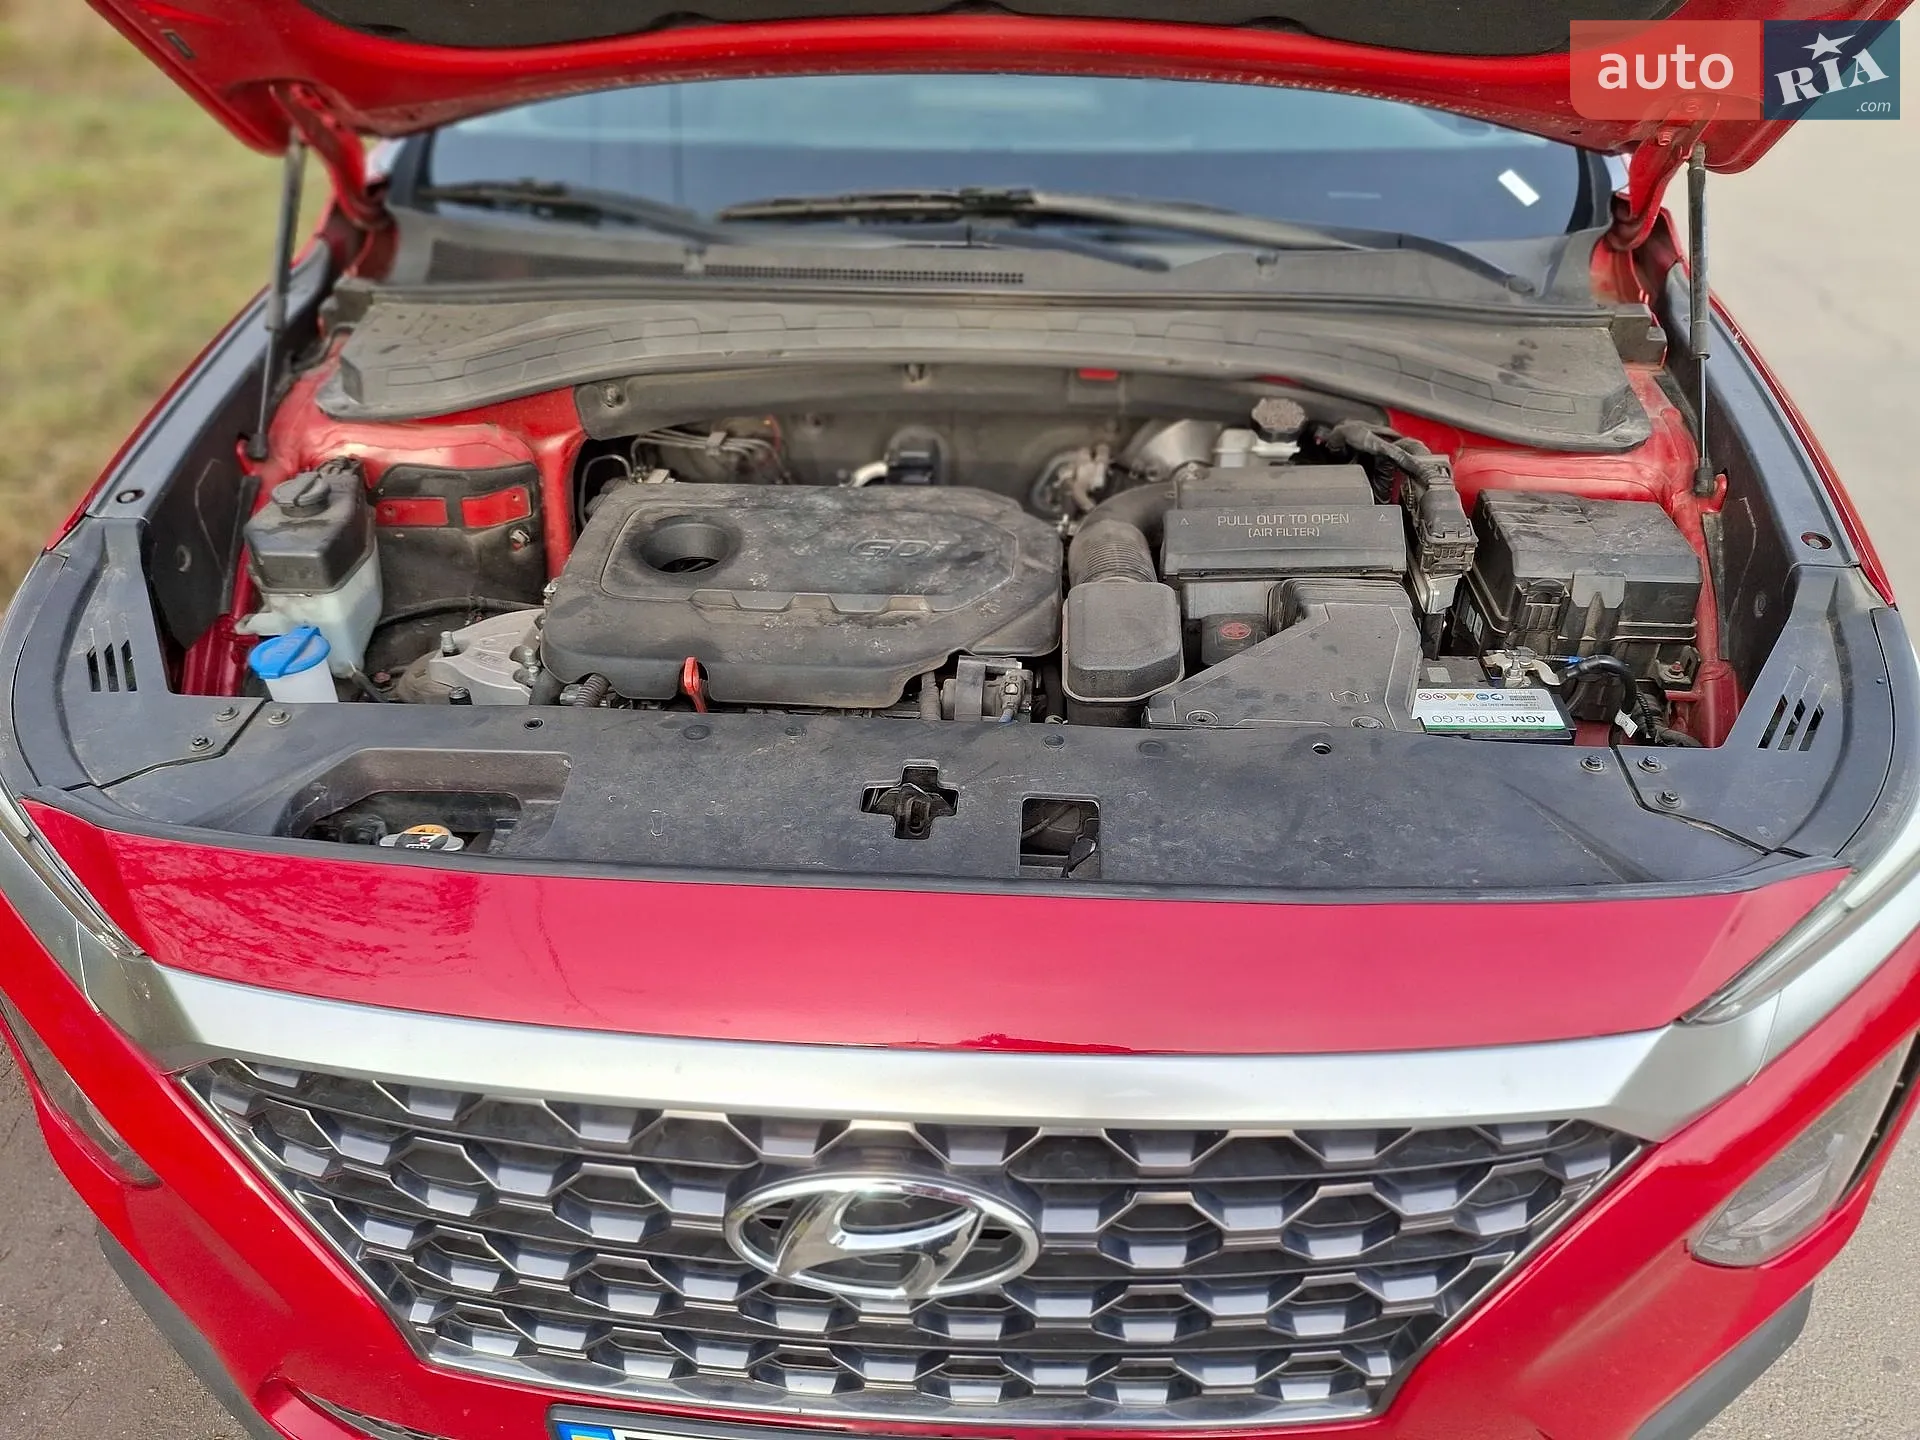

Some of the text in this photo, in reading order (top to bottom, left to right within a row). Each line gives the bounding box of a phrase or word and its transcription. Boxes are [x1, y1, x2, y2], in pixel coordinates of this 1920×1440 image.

[1217, 514, 1349, 526] PULL OUT TO OPEN
[1248, 526, 1320, 538] (AIR FILTER)
[1431, 715, 1546, 724] AGM STOP & GO
